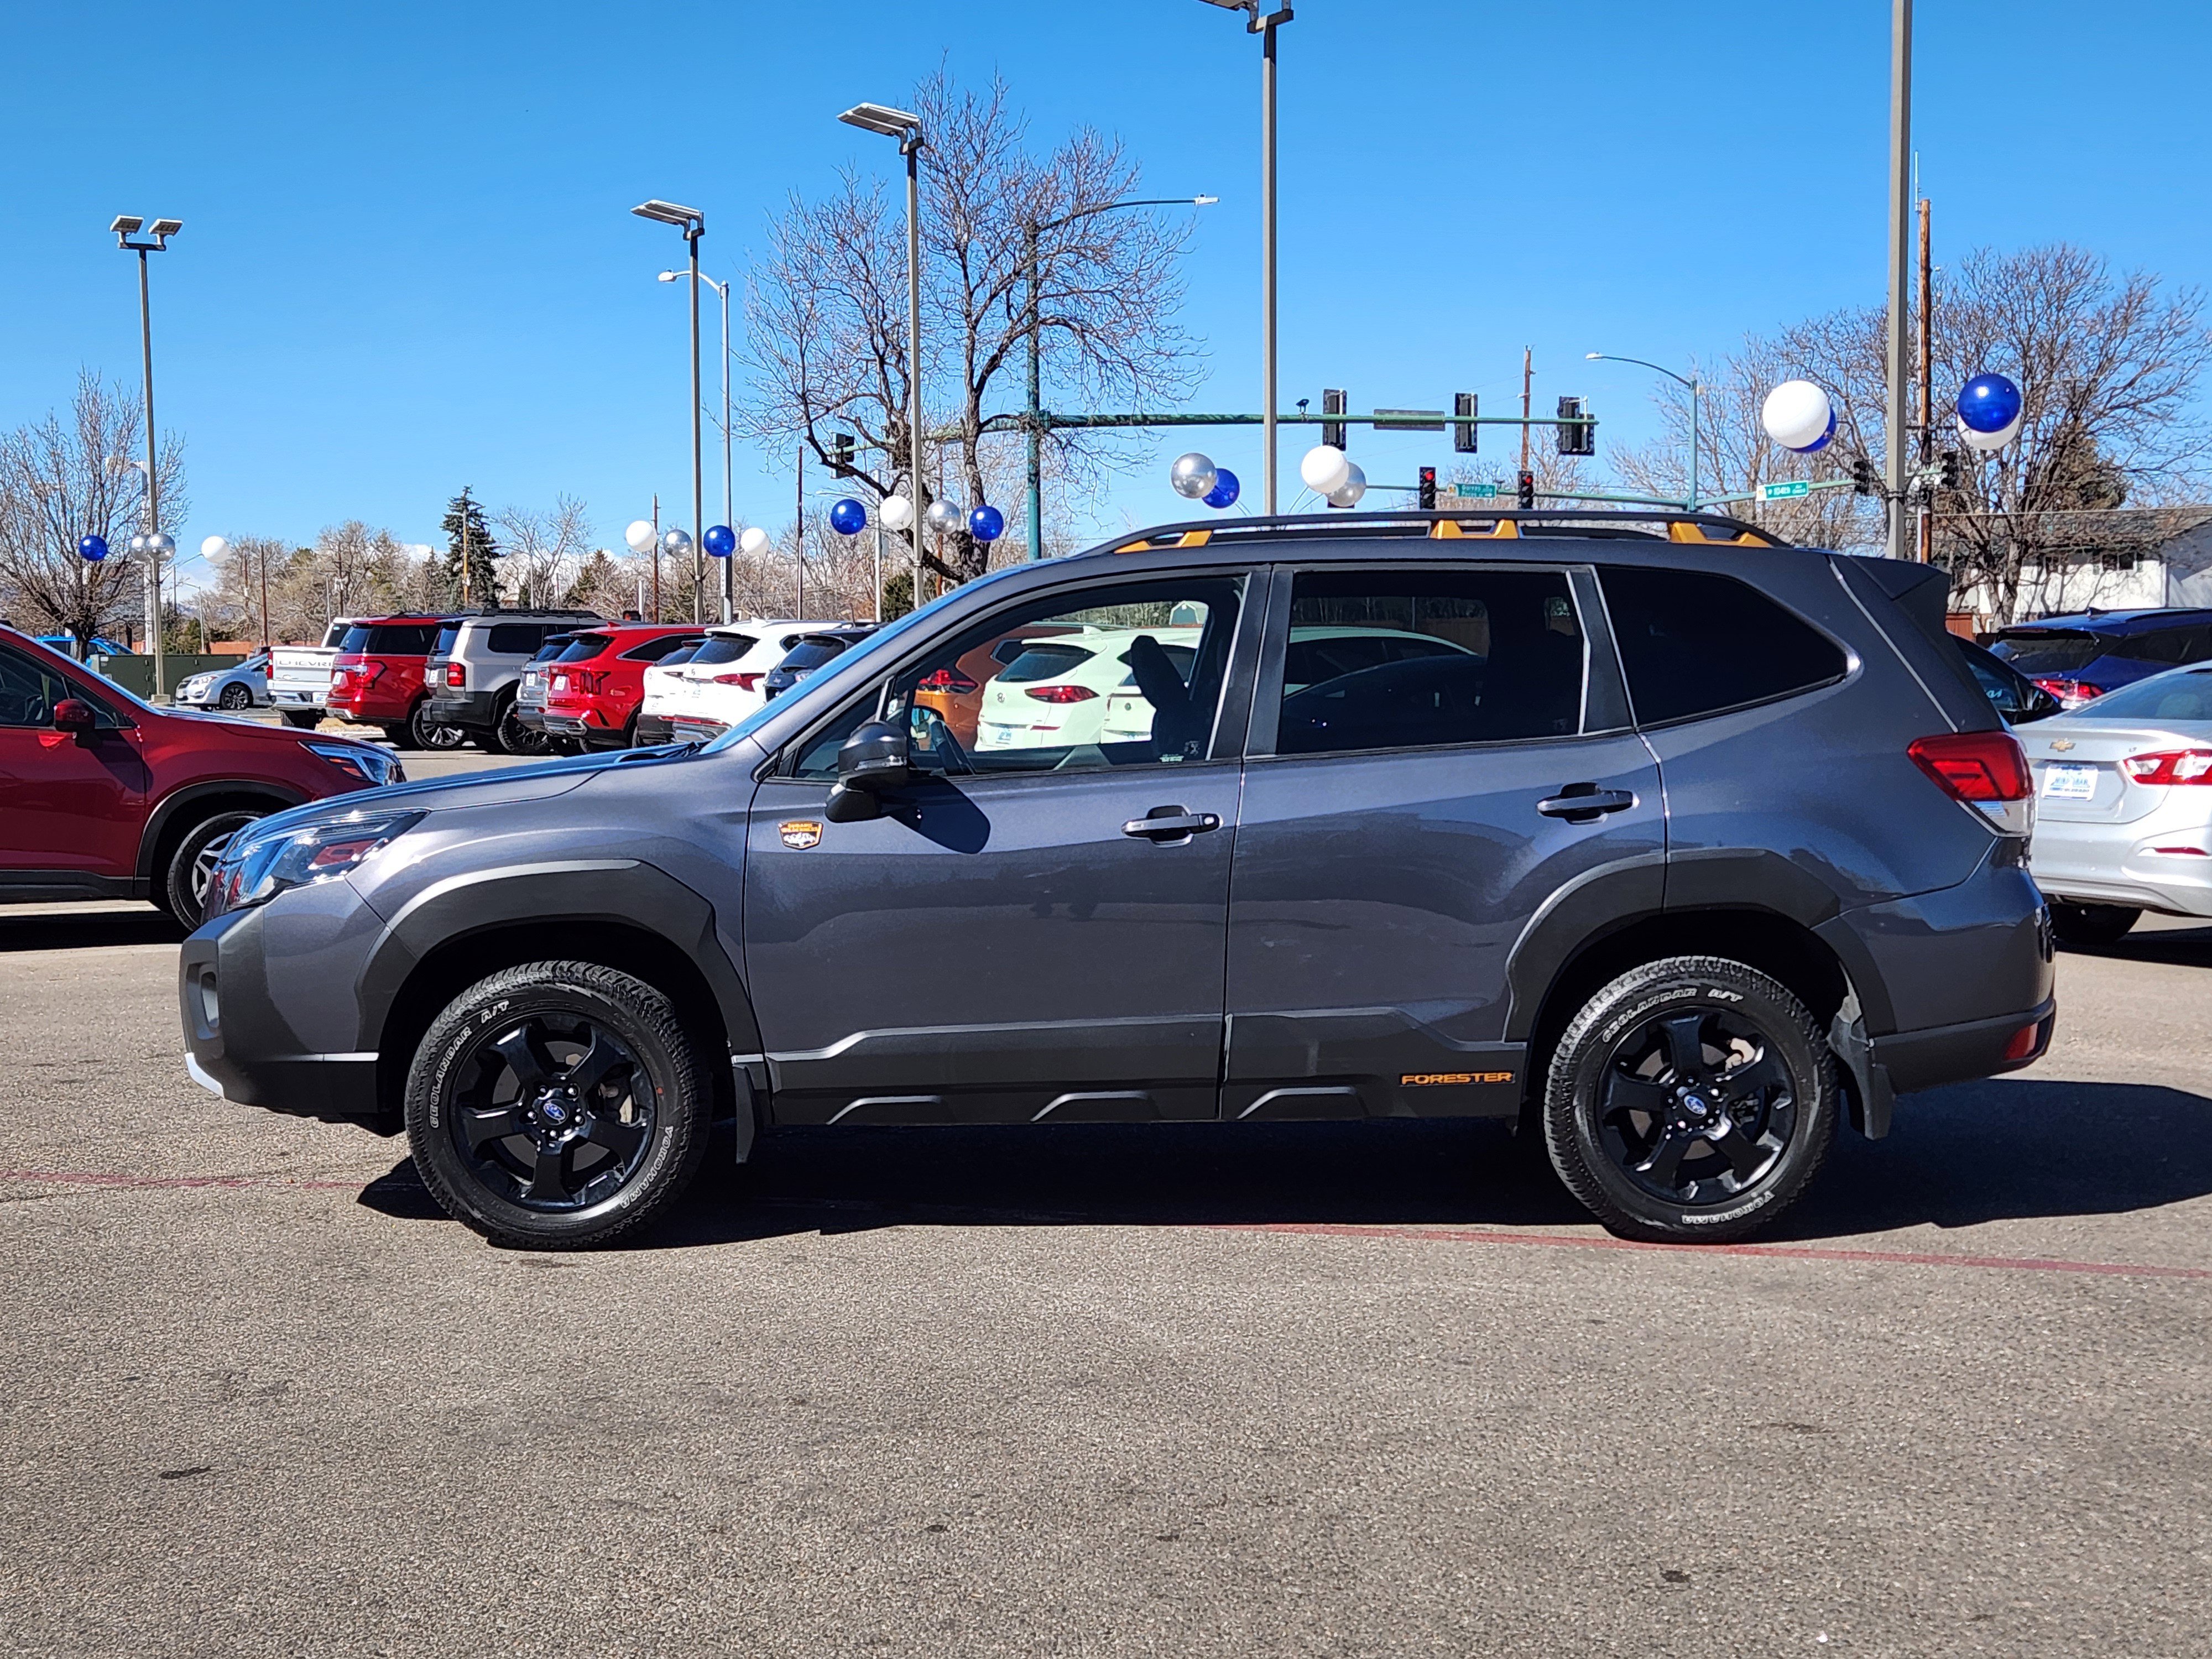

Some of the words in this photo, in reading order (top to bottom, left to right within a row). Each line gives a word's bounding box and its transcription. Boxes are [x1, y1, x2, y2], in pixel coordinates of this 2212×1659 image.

[1602, 988, 1698, 1043] GEOLANDAR
[1707, 988, 1744, 1003] A/T
[429, 1026, 473, 1129] GEOLANDAR
[481, 1000, 510, 1024] A/T
[1401, 1072, 1514, 1085] FORESTER
[619, 1125, 674, 1209] YOKOHAMA
[1681, 1190, 1776, 1225] YOKOHAMA
